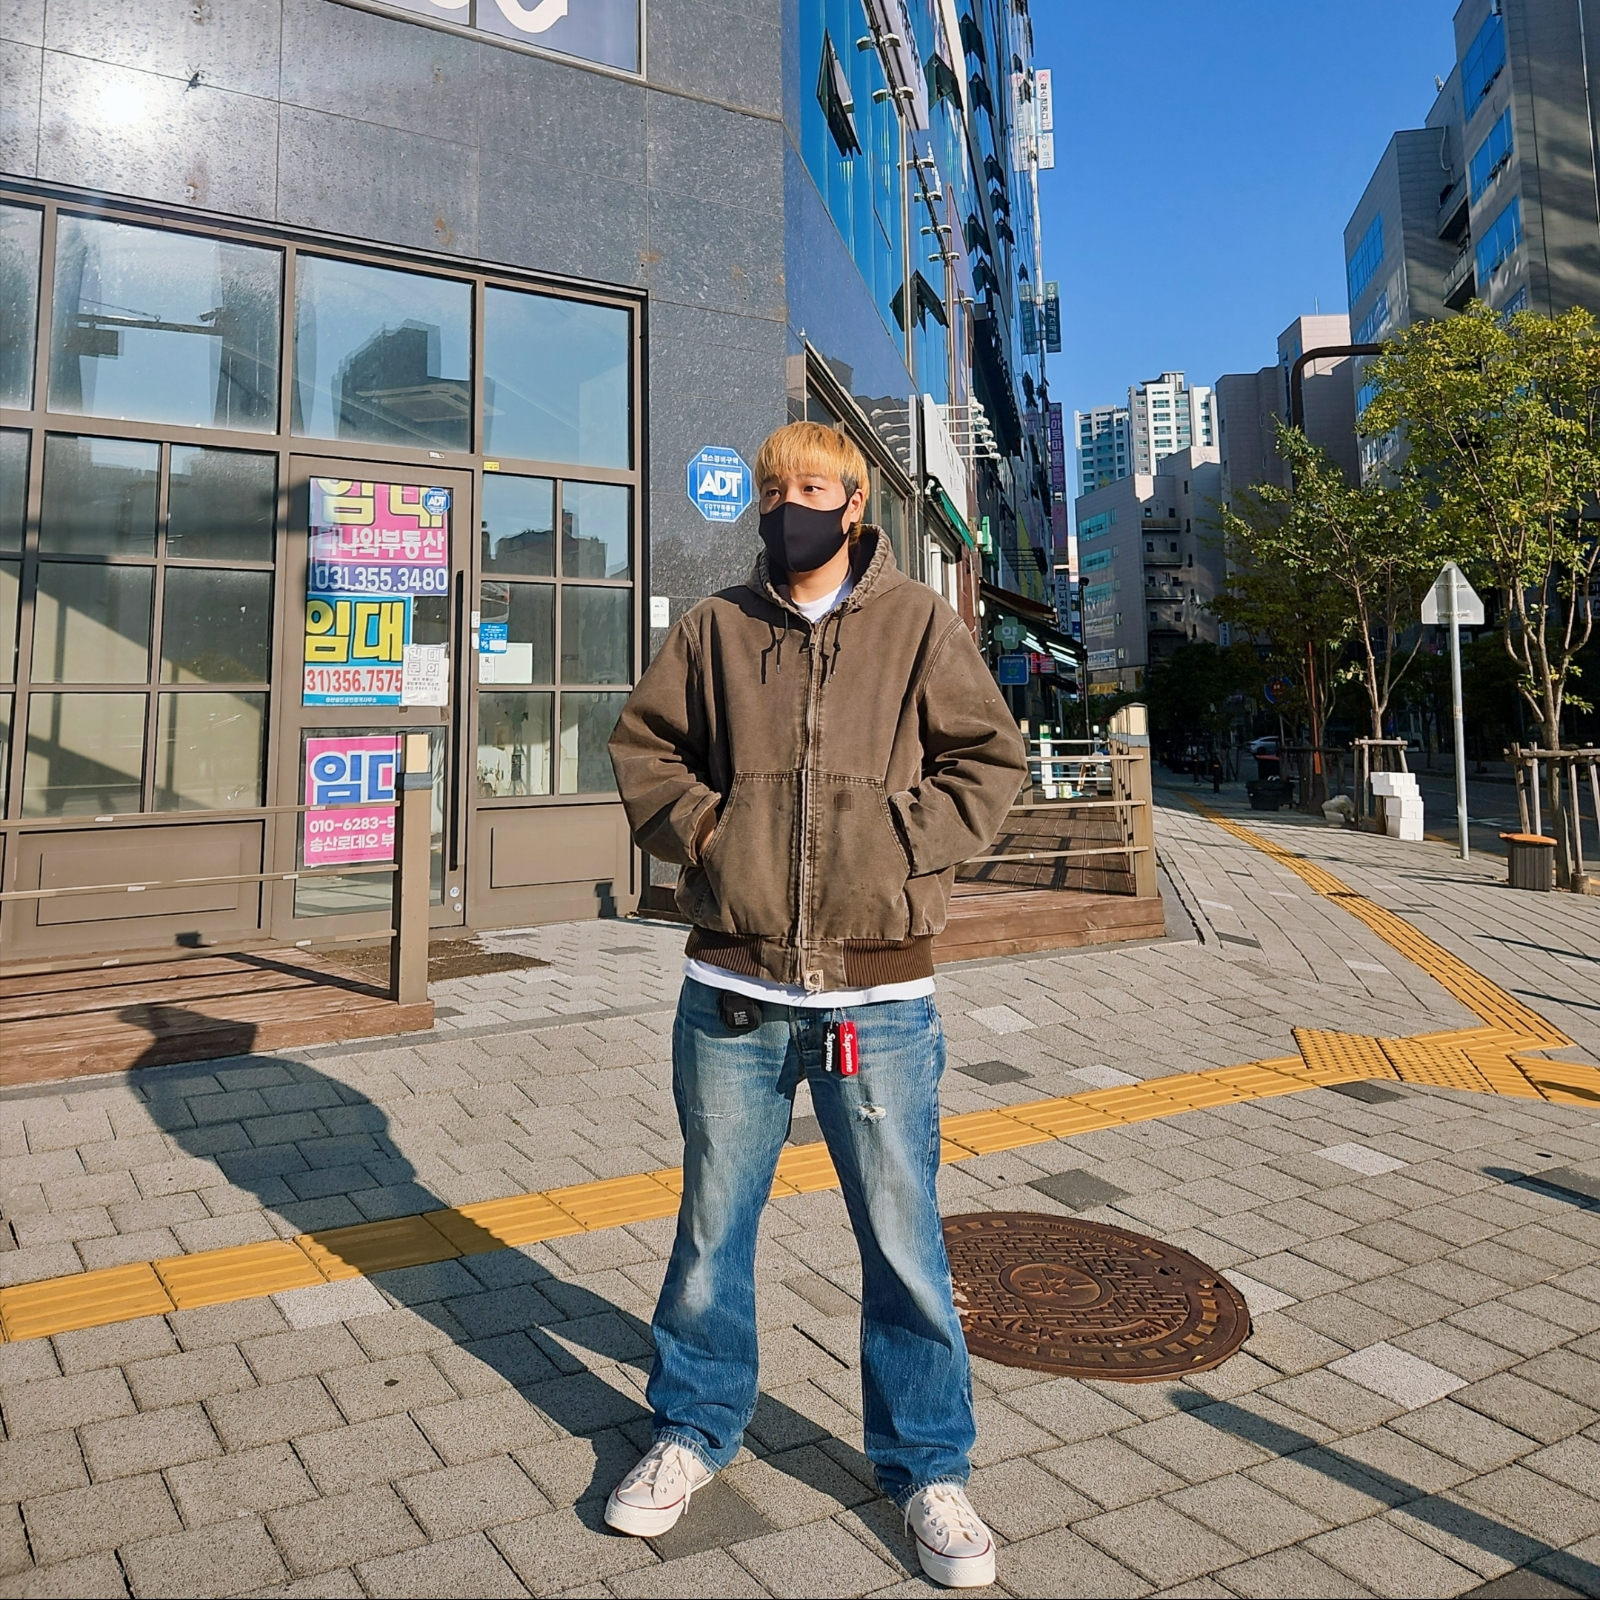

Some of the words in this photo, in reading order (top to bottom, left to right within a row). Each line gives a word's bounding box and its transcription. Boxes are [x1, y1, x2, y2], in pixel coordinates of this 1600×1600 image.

[1050, 419, 1063, 450] 아로마
[699, 470, 742, 498] ADT
[427, 495, 447, 507] ADT
[315, 566, 448, 592] 031.355.3480
[305, 598, 406, 663] 임대
[1001, 626, 1018, 643] 약
[305, 669, 402, 692] 31)356.7575
[310, 833, 379, 852] 송산로데오
[824, 1032, 836, 1073] Supreme
[841, 1033, 853, 1073] Supreme
[1020, 1280, 1070, 1297] SK
